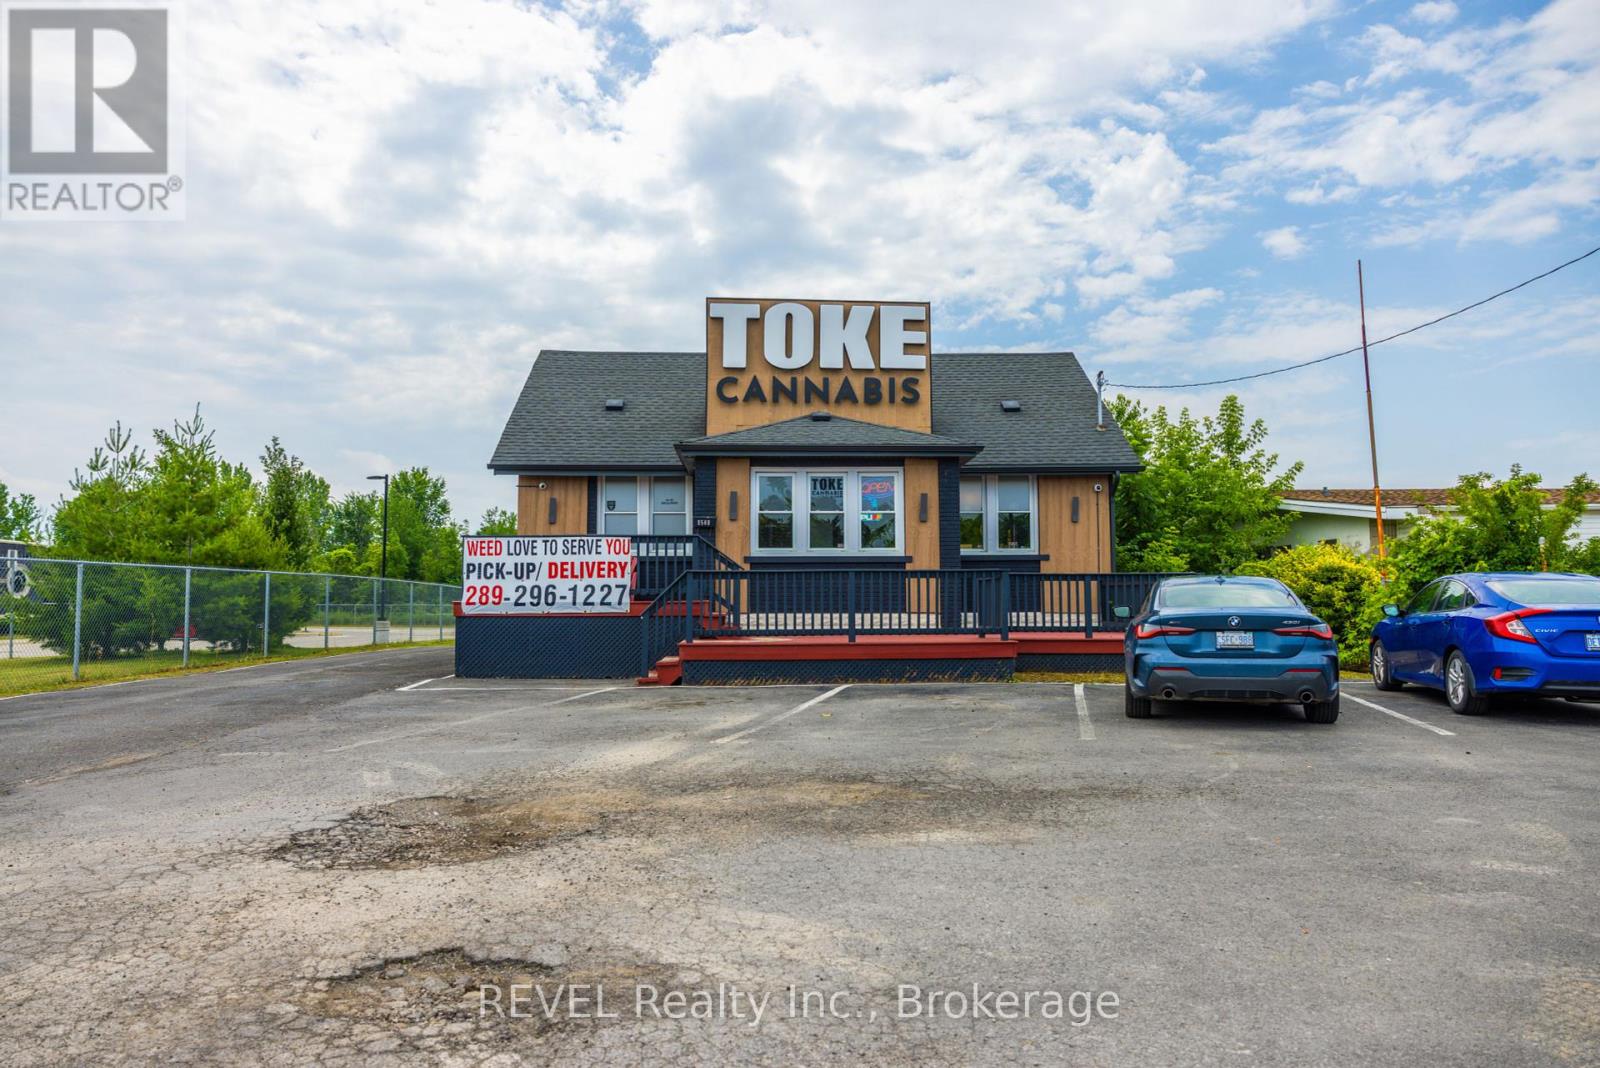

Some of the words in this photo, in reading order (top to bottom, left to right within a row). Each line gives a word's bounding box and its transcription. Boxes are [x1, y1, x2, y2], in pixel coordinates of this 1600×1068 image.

[709, 302, 927, 370] TOKE
[716, 375, 921, 404] CANNABIS
[811, 478, 844, 491] TOKE
[467, 540, 503, 557] WEED
[507, 539, 538, 556] LOVE
[543, 539, 558, 556] TO
[562, 538, 602, 555] SERVE
[606, 538, 630, 555] YOU
[466, 562, 542, 581] PICK-UP/
[548, 561, 628, 579] DELIVERY
[465, 584, 627, 607] 289-296-1227
